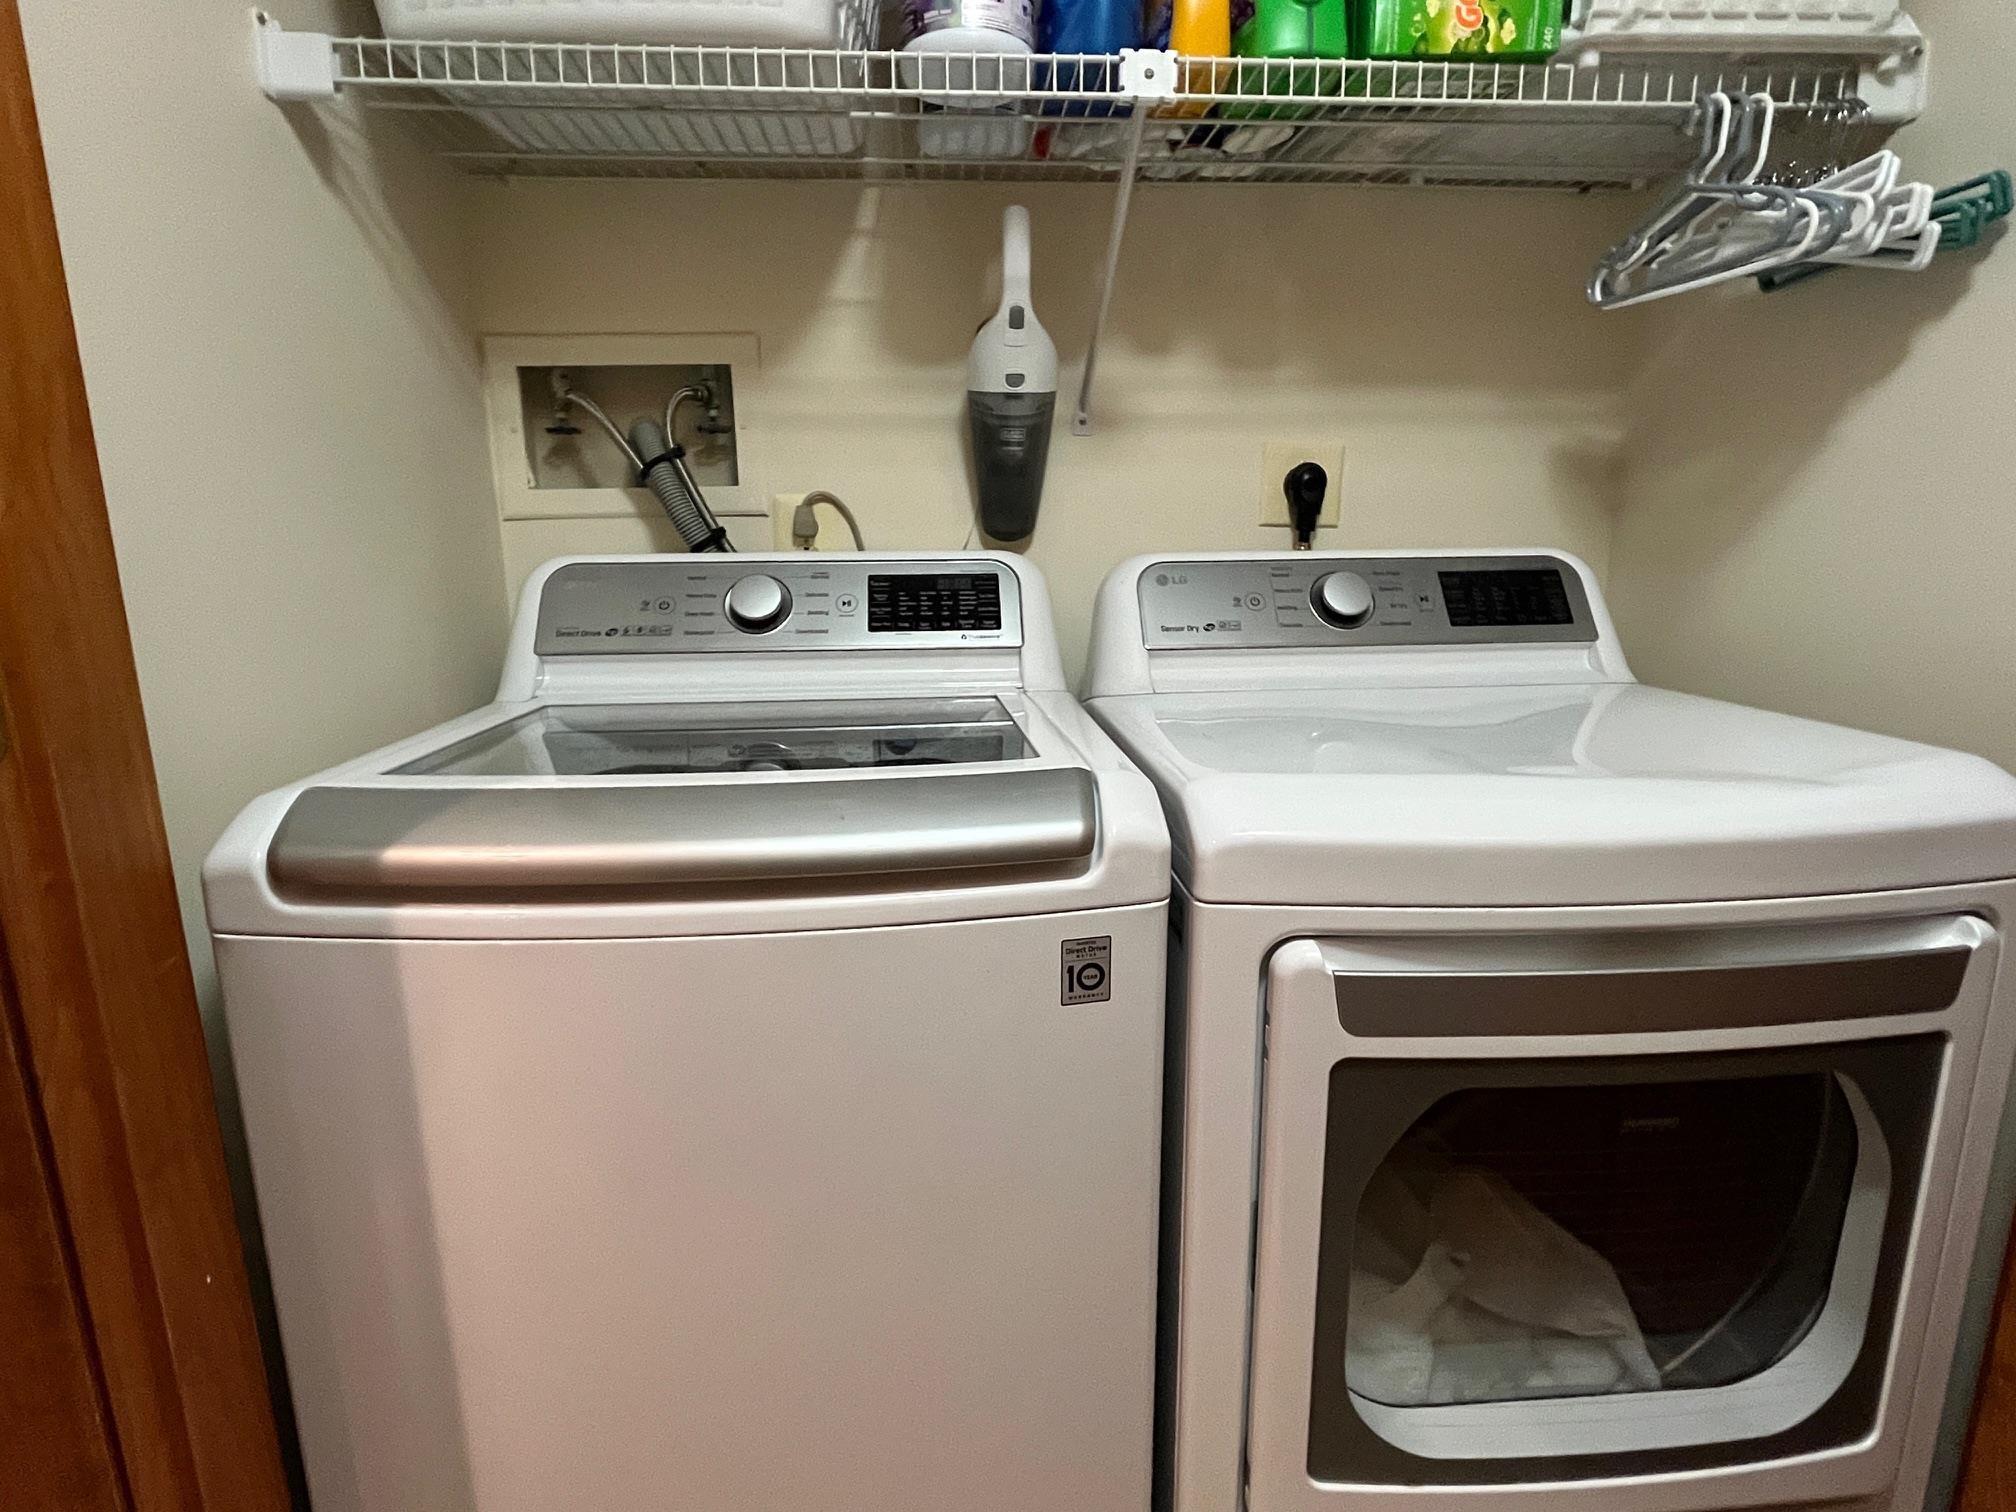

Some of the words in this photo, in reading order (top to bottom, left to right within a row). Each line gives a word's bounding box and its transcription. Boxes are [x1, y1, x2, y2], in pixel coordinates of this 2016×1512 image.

[1171, 576, 1188, 585] LG
[1186, 625, 1199, 633] Dry
[1067, 963, 1105, 993] 10
